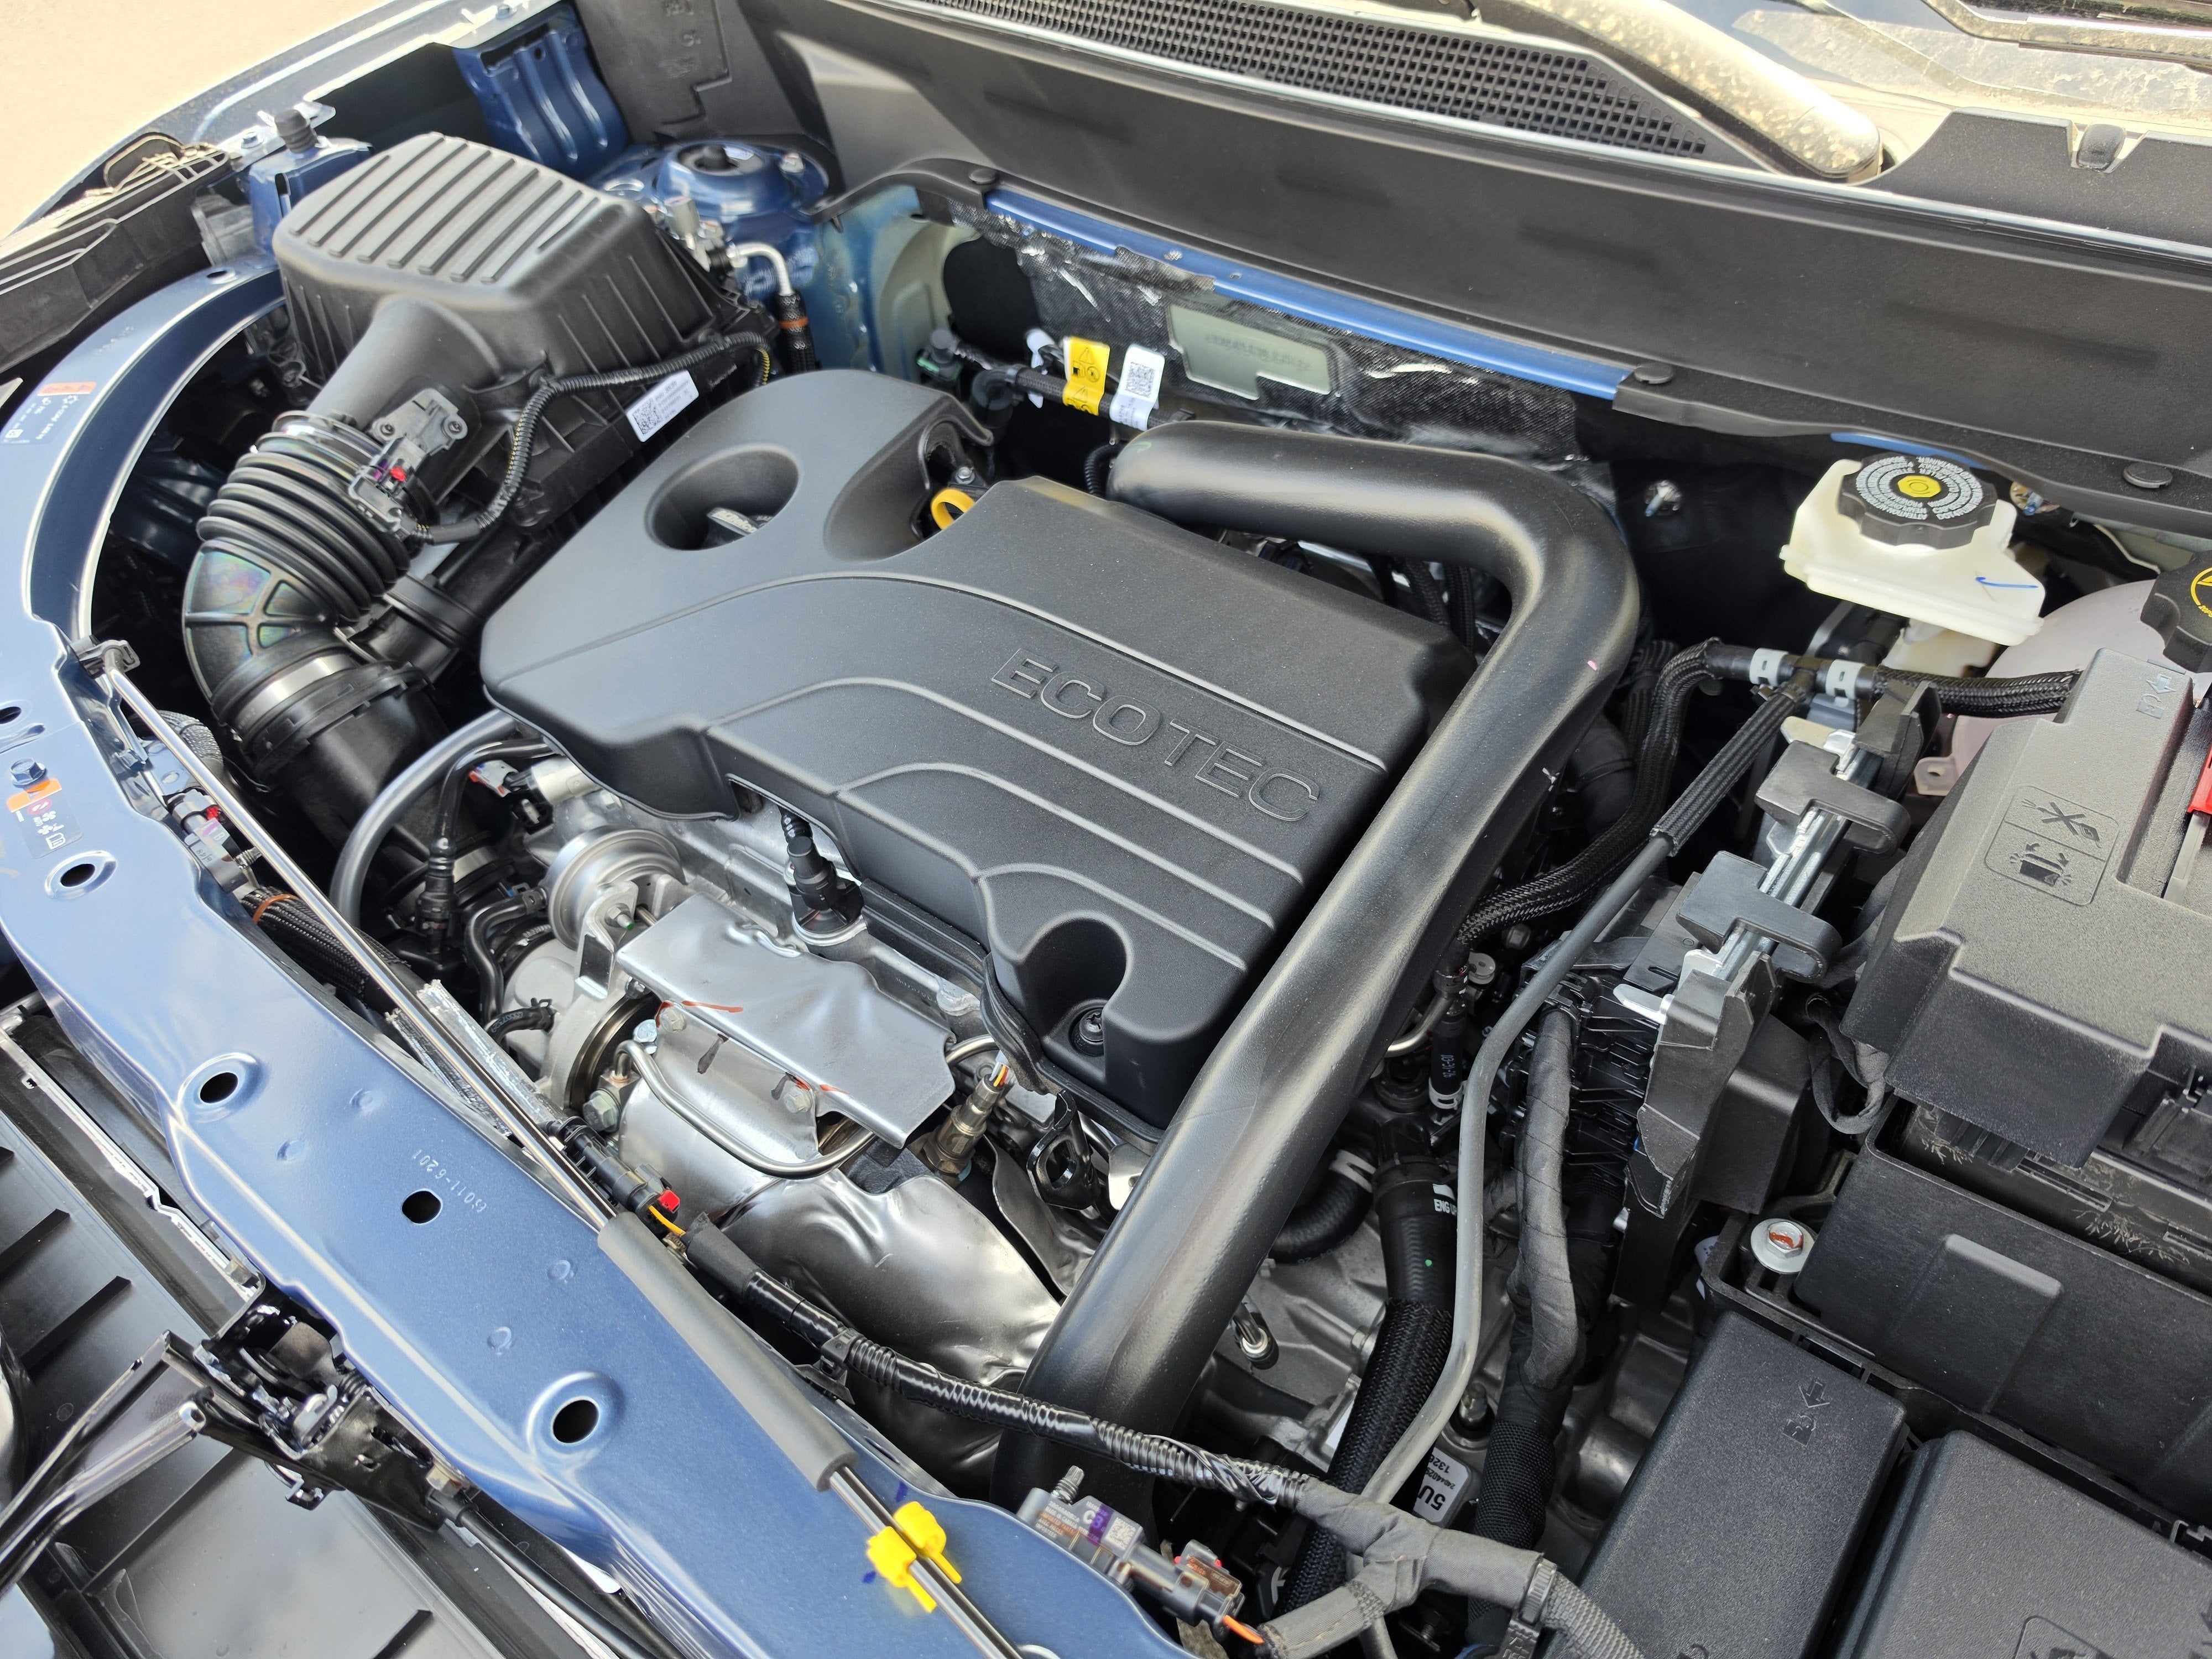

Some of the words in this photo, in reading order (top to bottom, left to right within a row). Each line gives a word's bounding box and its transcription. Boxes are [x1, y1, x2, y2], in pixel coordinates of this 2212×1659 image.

[1917, 461, 1942, 471] ONLY
[1919, 468, 1948, 479] FILLER
[1941, 477, 1958, 492] CLEAN
[1958, 470, 1983, 488] SEALED
[991, 648, 1321, 822] ECOTEC
[1433, 1199, 1450, 1213] ENG
[1045, 1506, 1057, 1516] MADE
[1061, 1516, 1078, 1529] CANADA
[1083, 1510, 1103, 1528] CB
